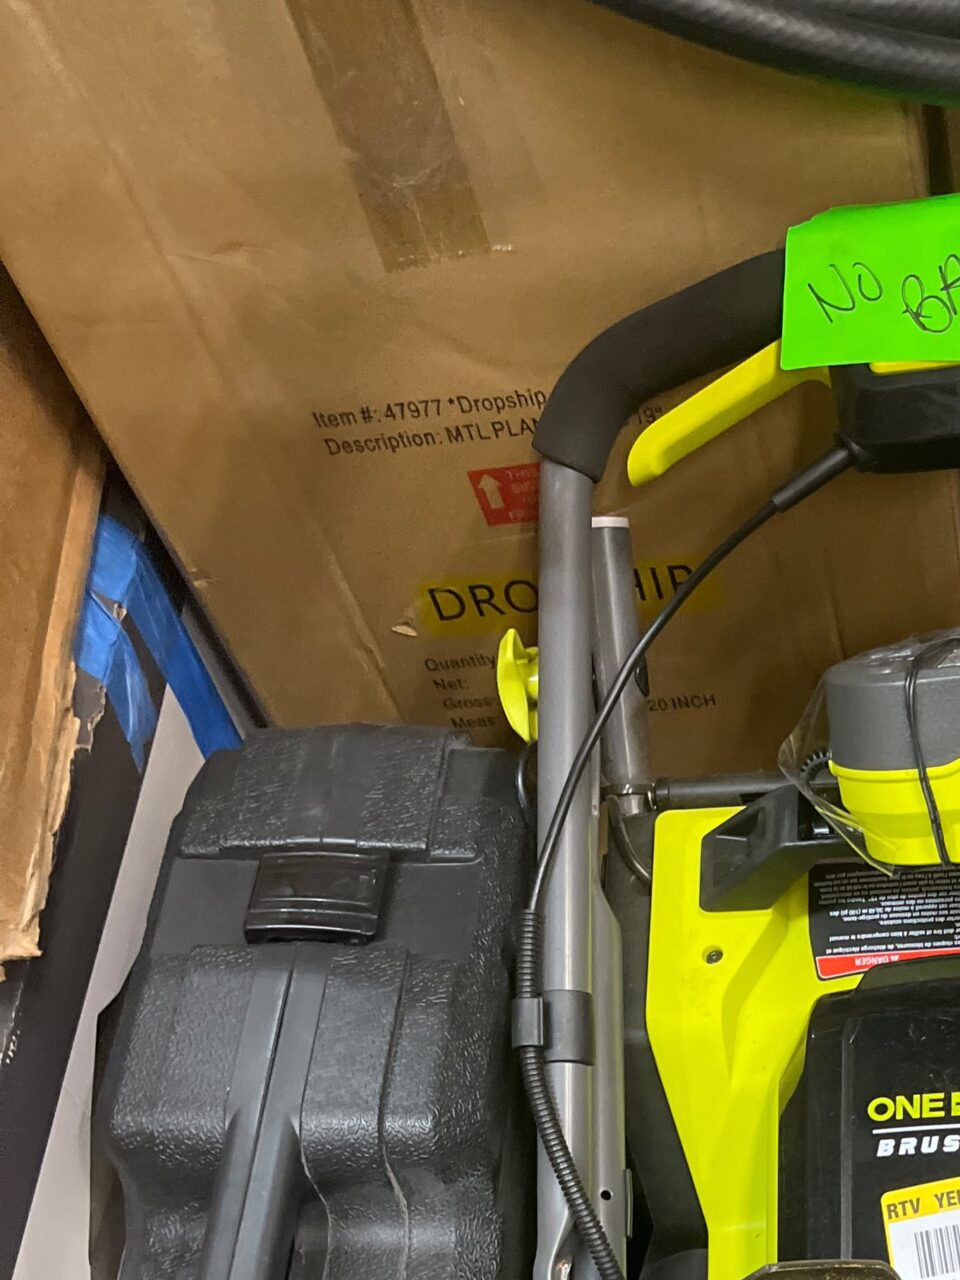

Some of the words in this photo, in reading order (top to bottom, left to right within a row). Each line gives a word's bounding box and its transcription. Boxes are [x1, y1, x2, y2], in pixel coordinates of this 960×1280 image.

[806, 261, 884, 324] NO
[312, 409, 357, 429] Item
[360, 406, 382, 424] #:
[385, 399, 442, 421] 47977
[323, 430, 443, 456] Description:
[444, 424, 491, 444] MTL
[424, 653, 496, 672] Quantity
[648, 699, 668, 713] 20
[672, 694, 717, 709] INCH
[855, 956, 889, 966] DANGER
[886, 1197, 921, 1220] RTV
